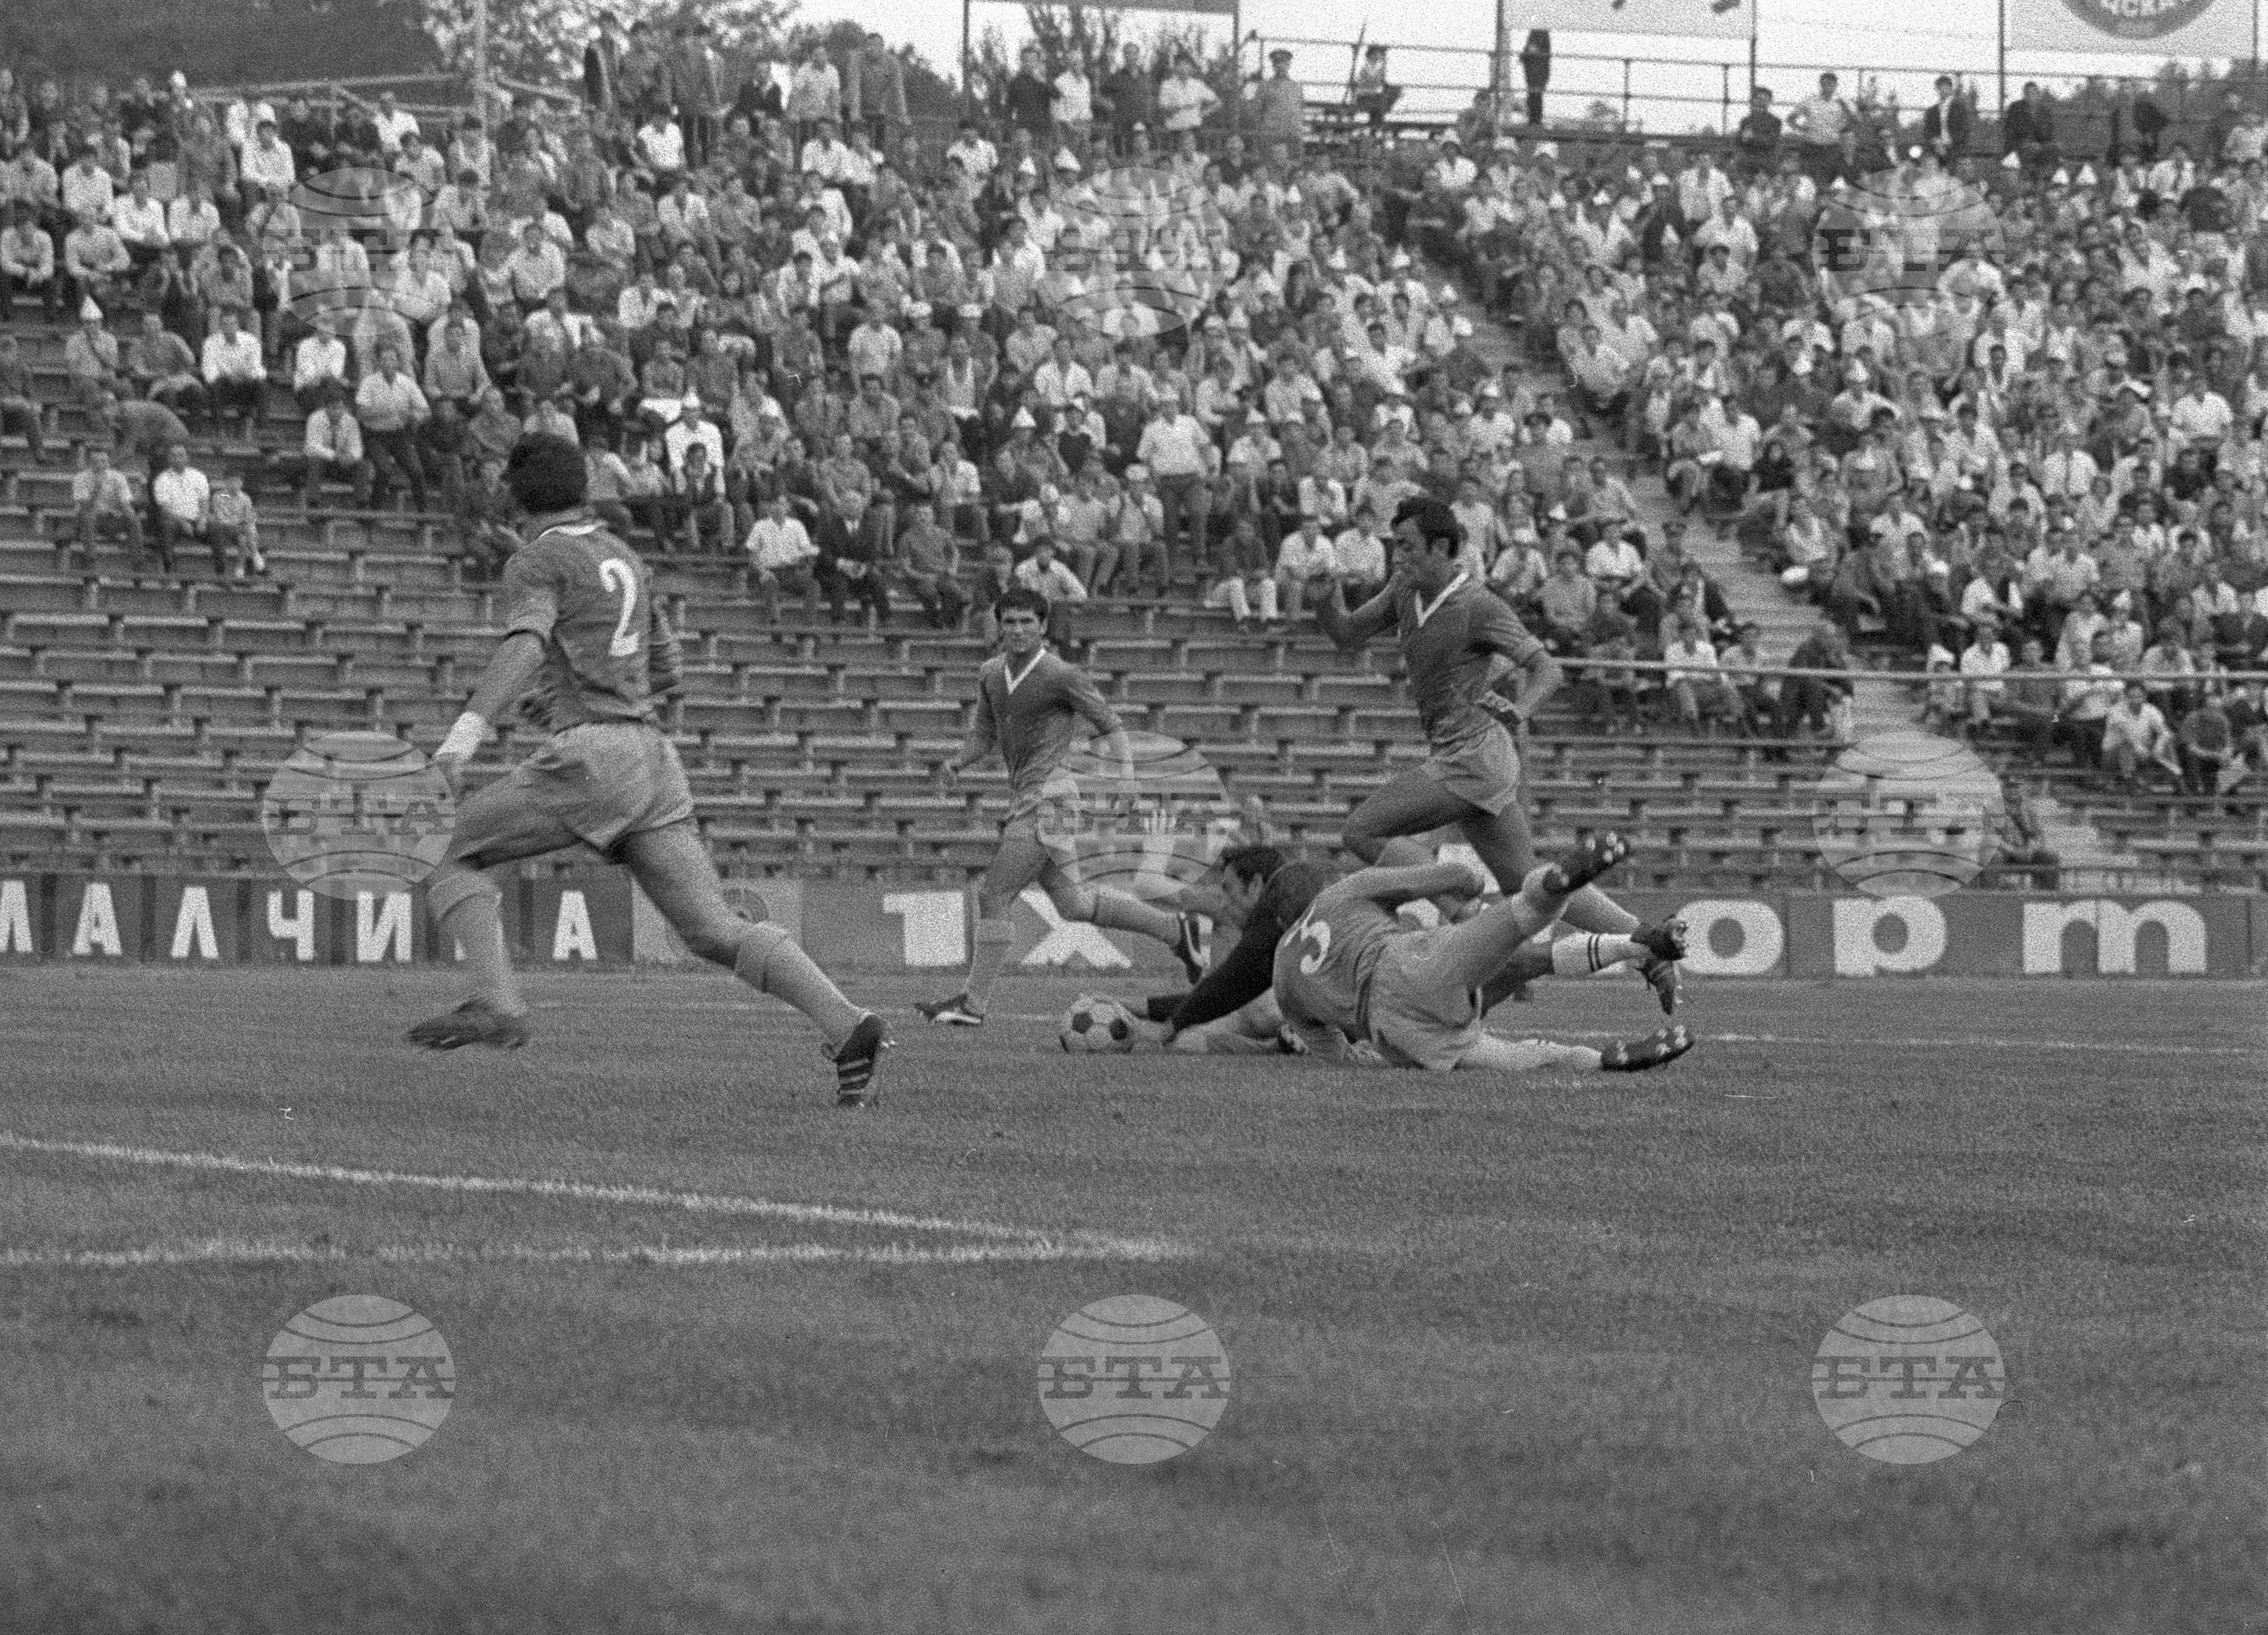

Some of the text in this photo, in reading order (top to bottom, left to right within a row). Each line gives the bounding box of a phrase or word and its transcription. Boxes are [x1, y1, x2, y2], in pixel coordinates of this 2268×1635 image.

[599, 558, 639, 657] 2
[0, 880, 598, 962] АЛЧИА
[1284, 903, 1331, 974] 3
